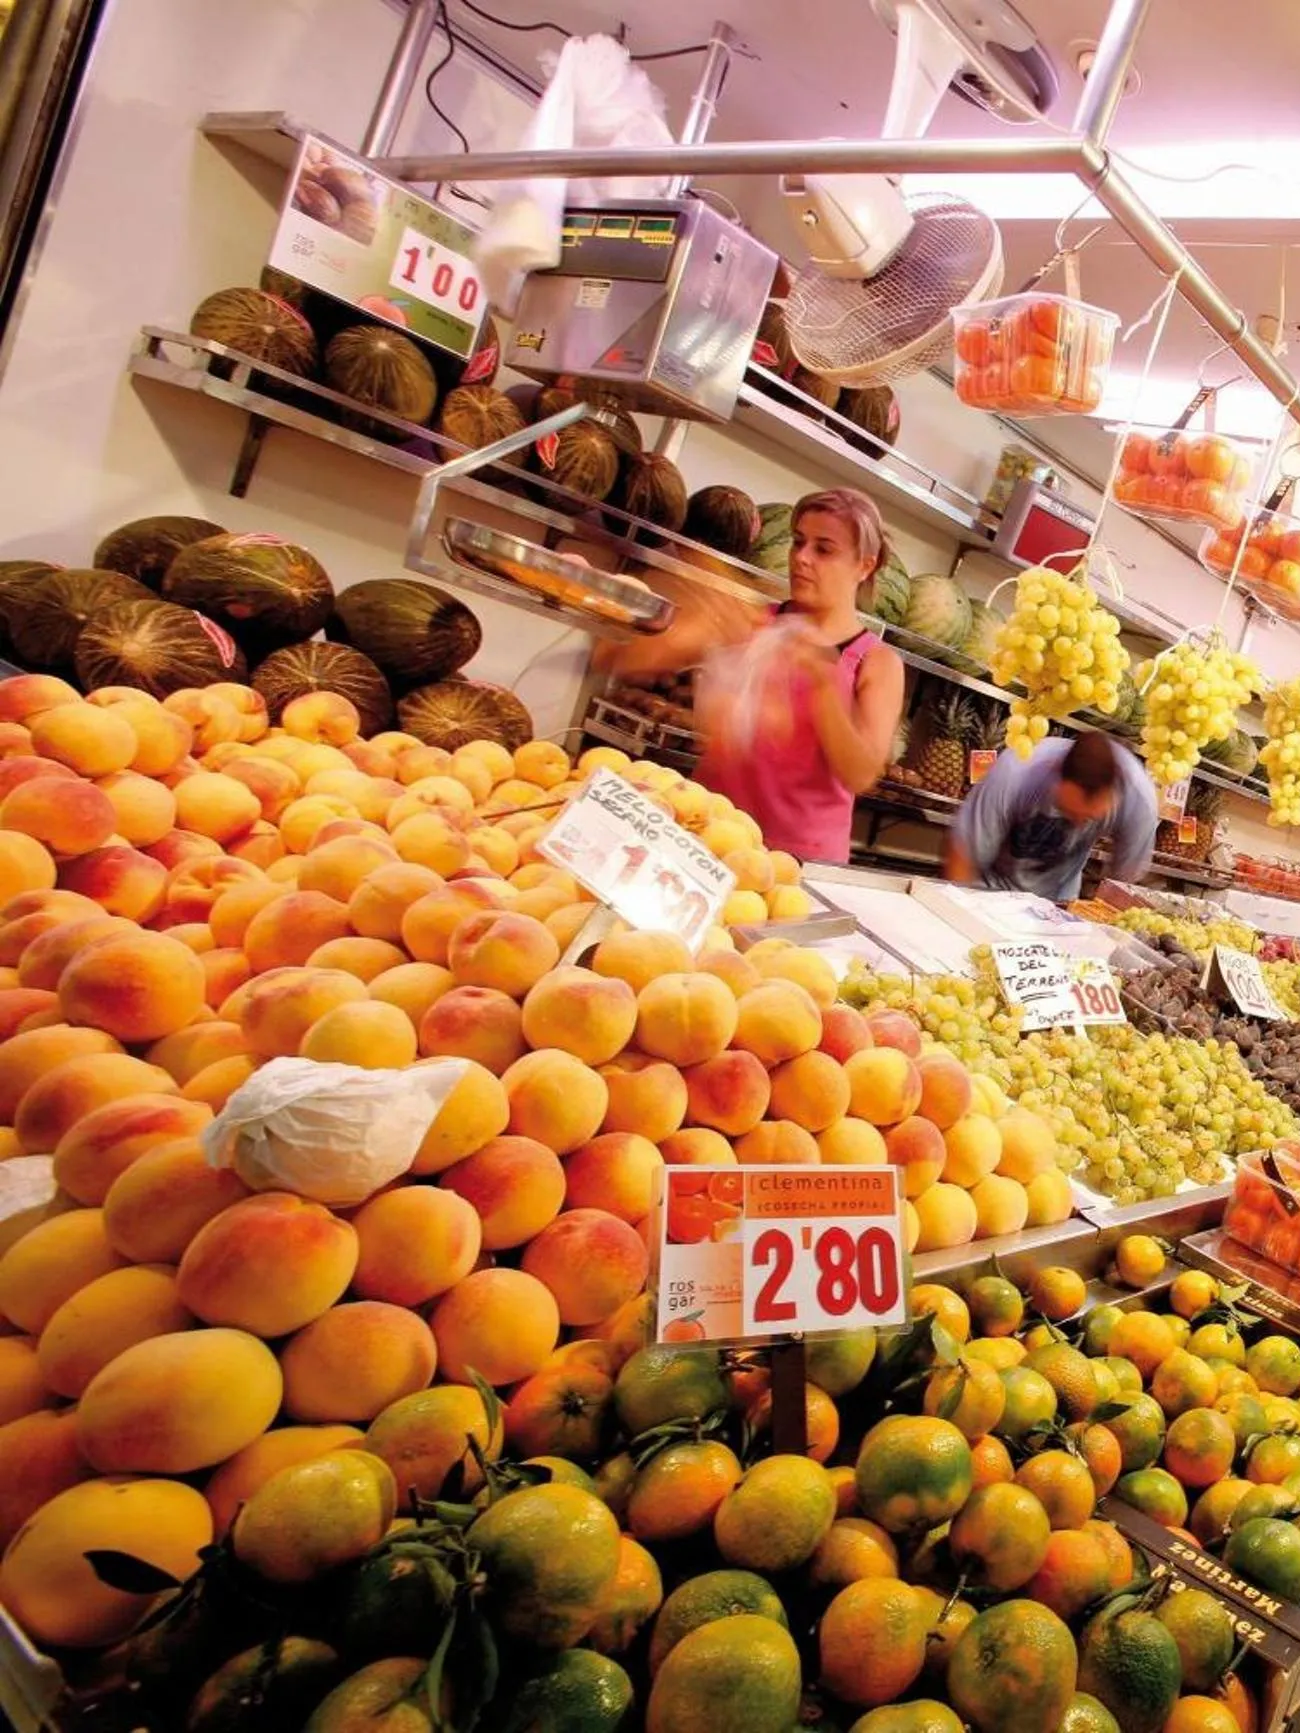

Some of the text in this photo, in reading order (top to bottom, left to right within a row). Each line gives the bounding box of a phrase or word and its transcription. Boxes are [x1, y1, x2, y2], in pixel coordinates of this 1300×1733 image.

[401, 246, 478, 311] 1'00
[600, 779, 727, 883] MELOCOTON
[1018, 959, 1047, 971] DEL
[759, 1174, 882, 1191] clementina
[669, 1280, 695, 1292] ros
[752, 1226, 899, 1323] 2'80
[668, 1296, 695, 1311] gar
[1169, 1541, 1283, 1617] Martinez
